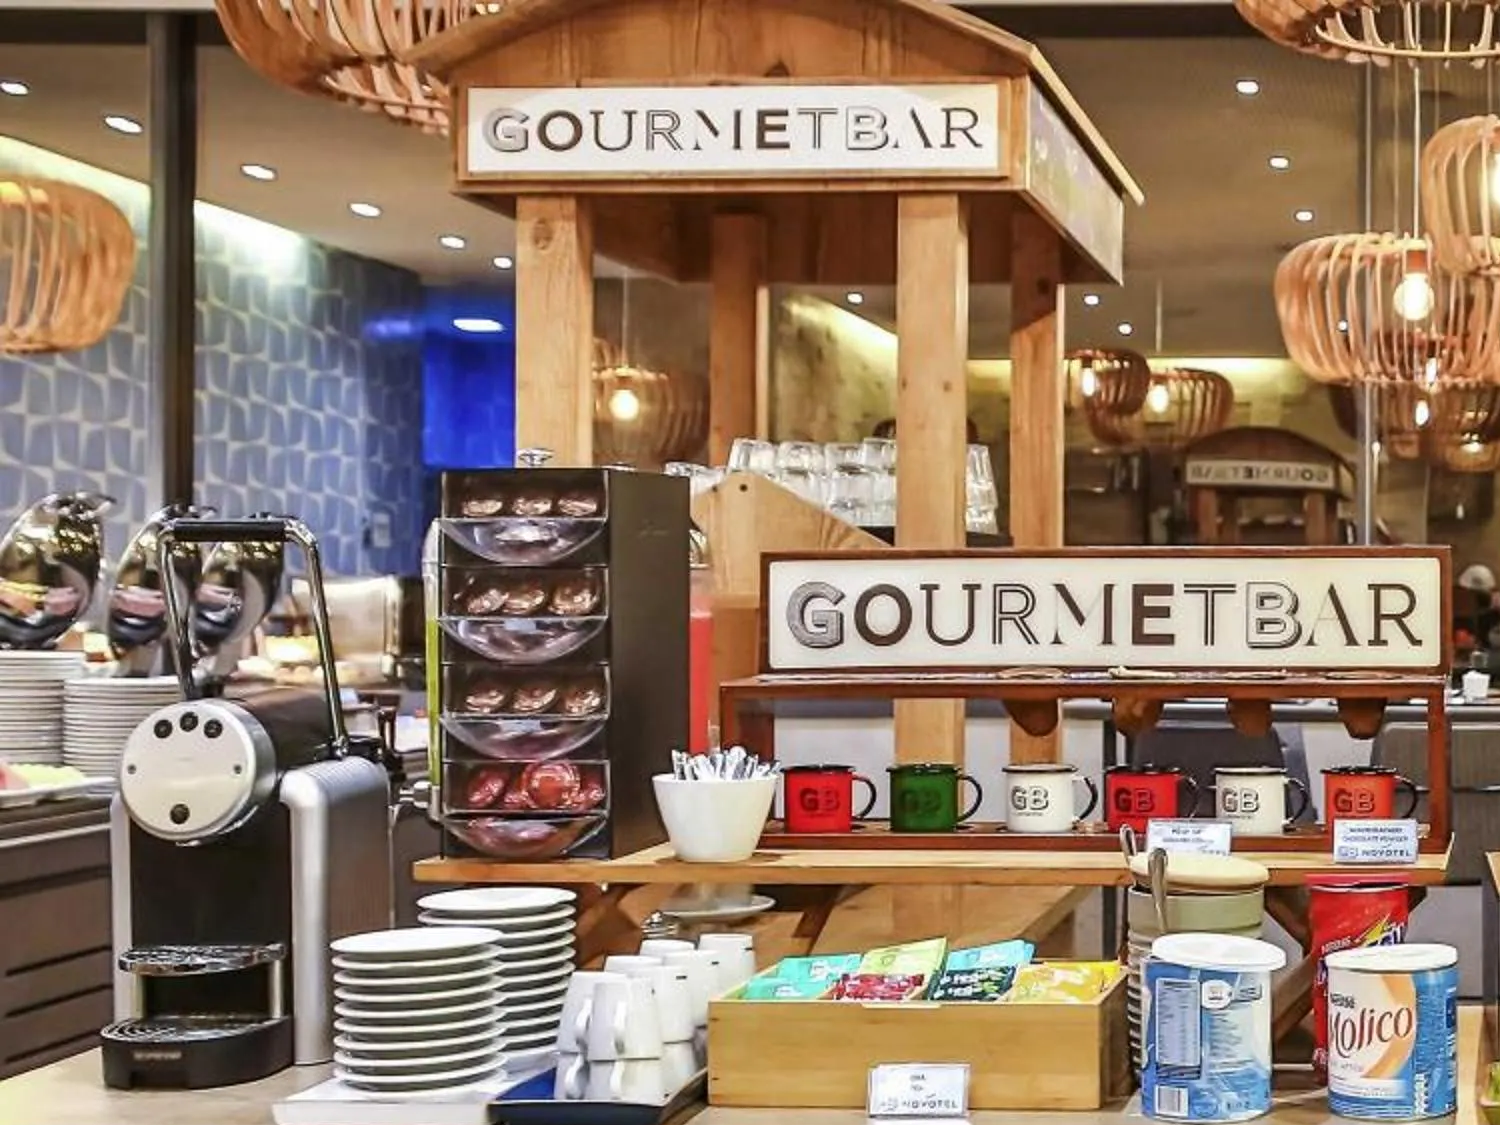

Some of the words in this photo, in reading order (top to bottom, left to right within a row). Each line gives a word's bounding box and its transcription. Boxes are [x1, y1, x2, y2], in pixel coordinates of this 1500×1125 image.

[785, 580, 1424, 650] GOURMETBAR
[1010, 785, 1050, 812] GB
[1113, 787, 1156, 814] GB
[1220, 787, 1261, 814] GB
[1333, 787, 1376, 814] GB
